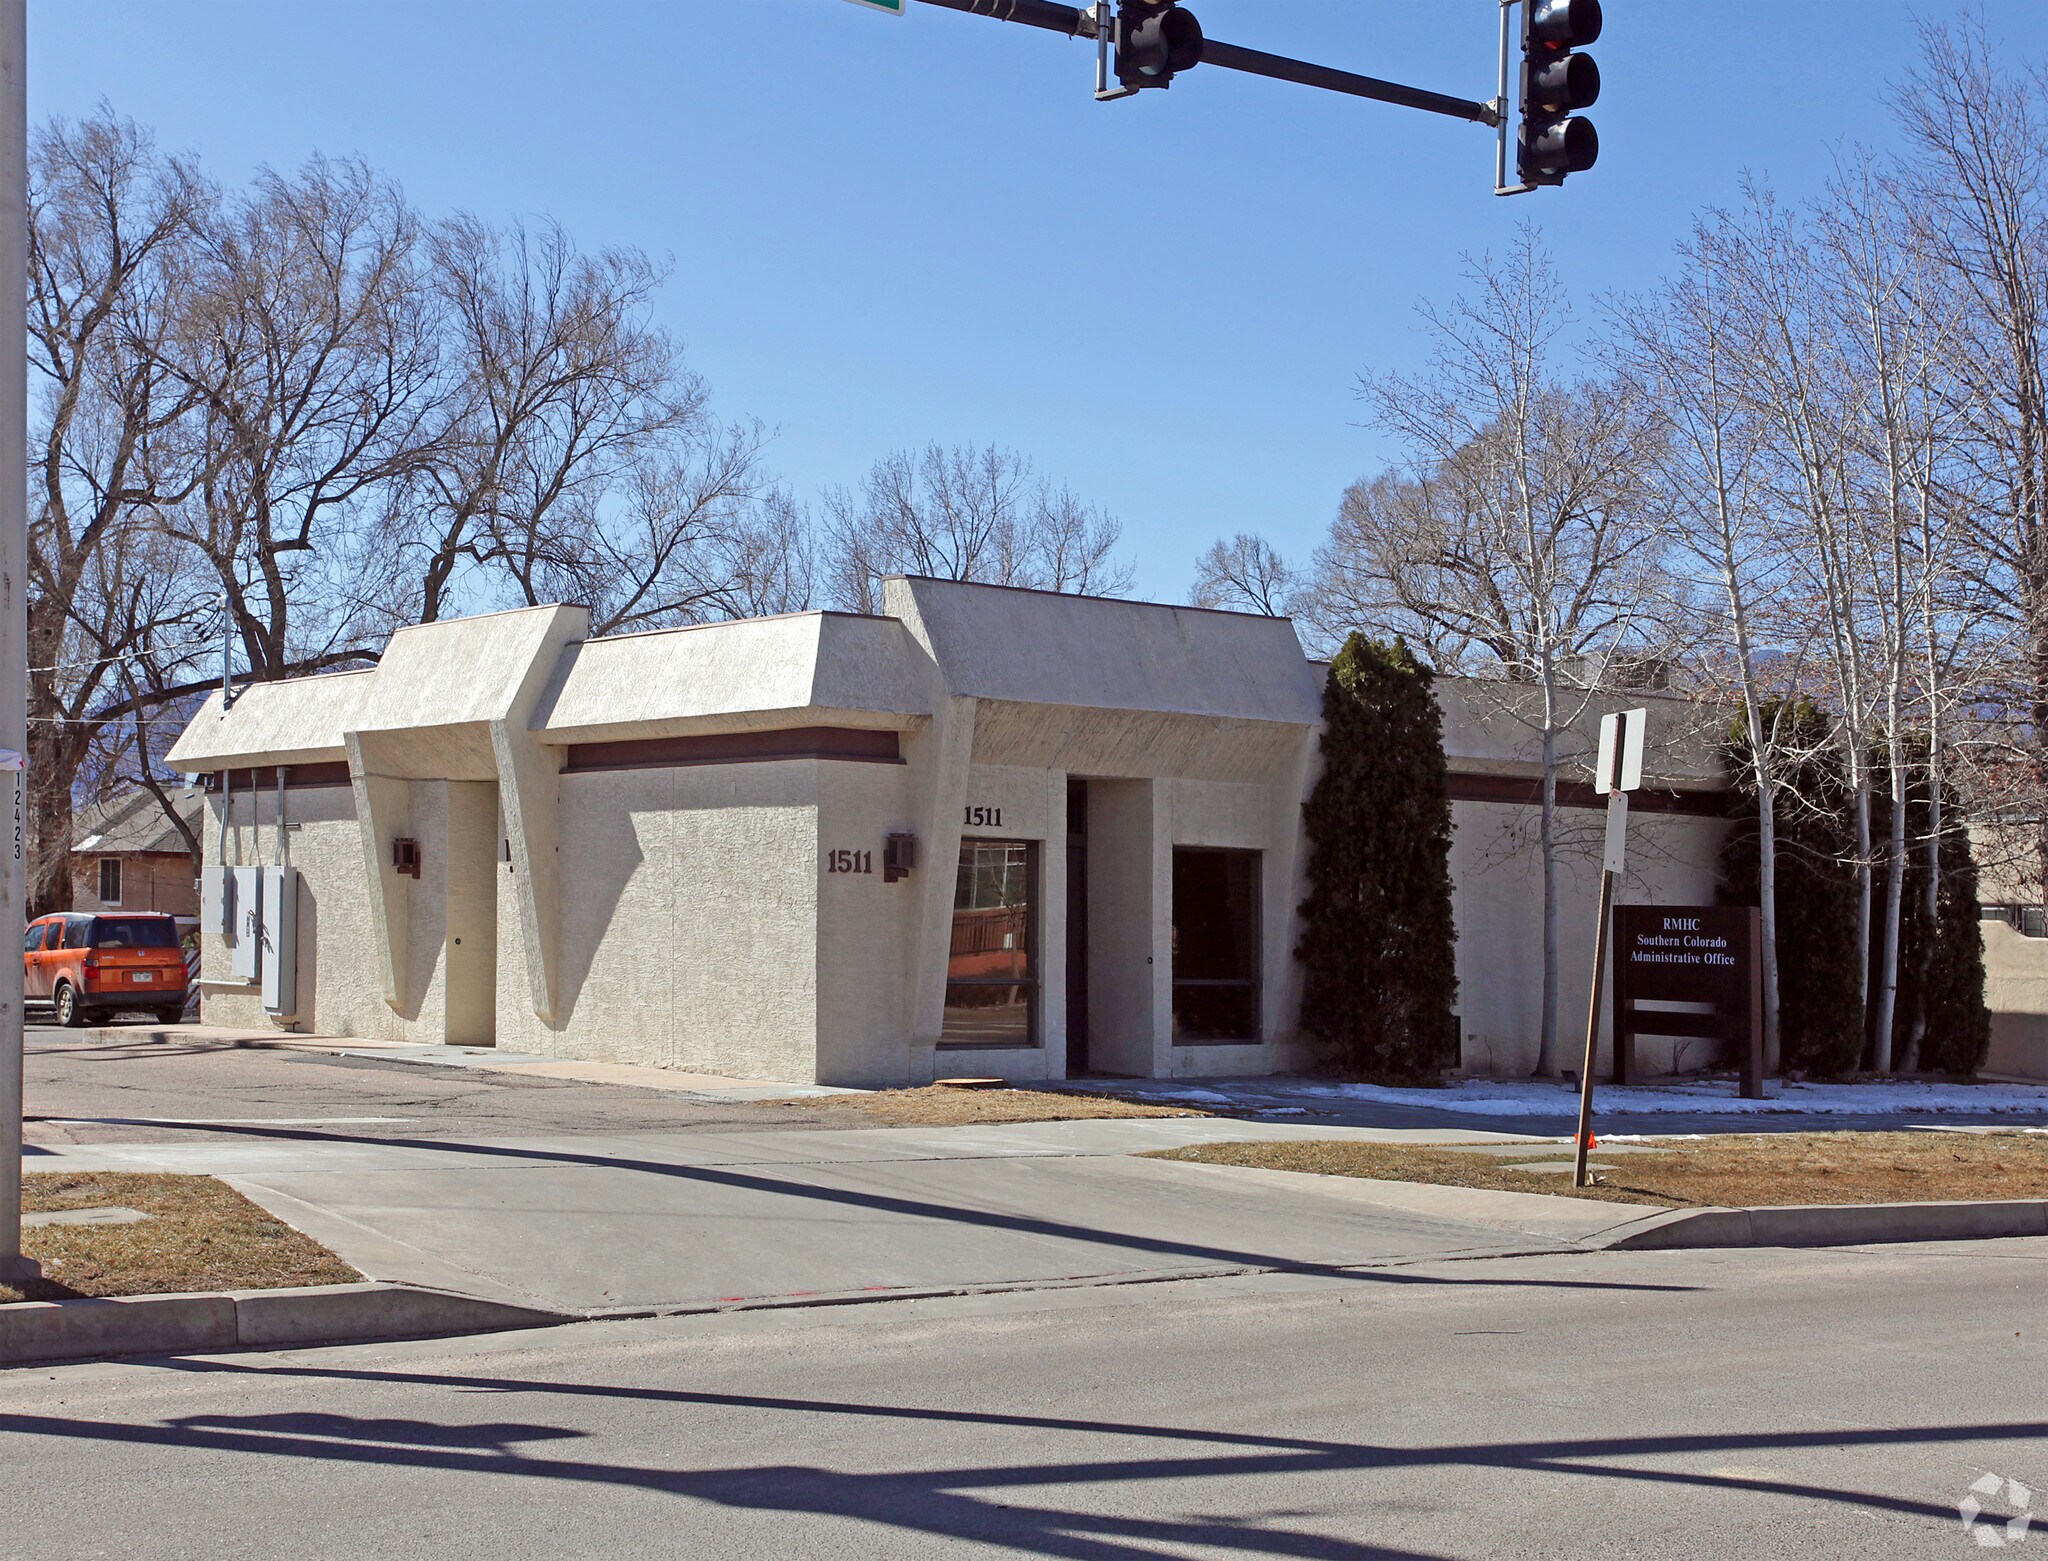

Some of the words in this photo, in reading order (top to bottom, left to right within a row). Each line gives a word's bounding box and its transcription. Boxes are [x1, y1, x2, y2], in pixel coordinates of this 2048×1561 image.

[963, 806, 1003, 827] 1511
[828, 849, 873, 874] 1511
[1663, 917, 1701, 931] RMHC
[1637, 934, 1680, 947] Southern
[1683, 935, 1727, 948] Colorado
[1630, 950, 1701, 964] Administrative
[1704, 952, 1735, 965] Office
